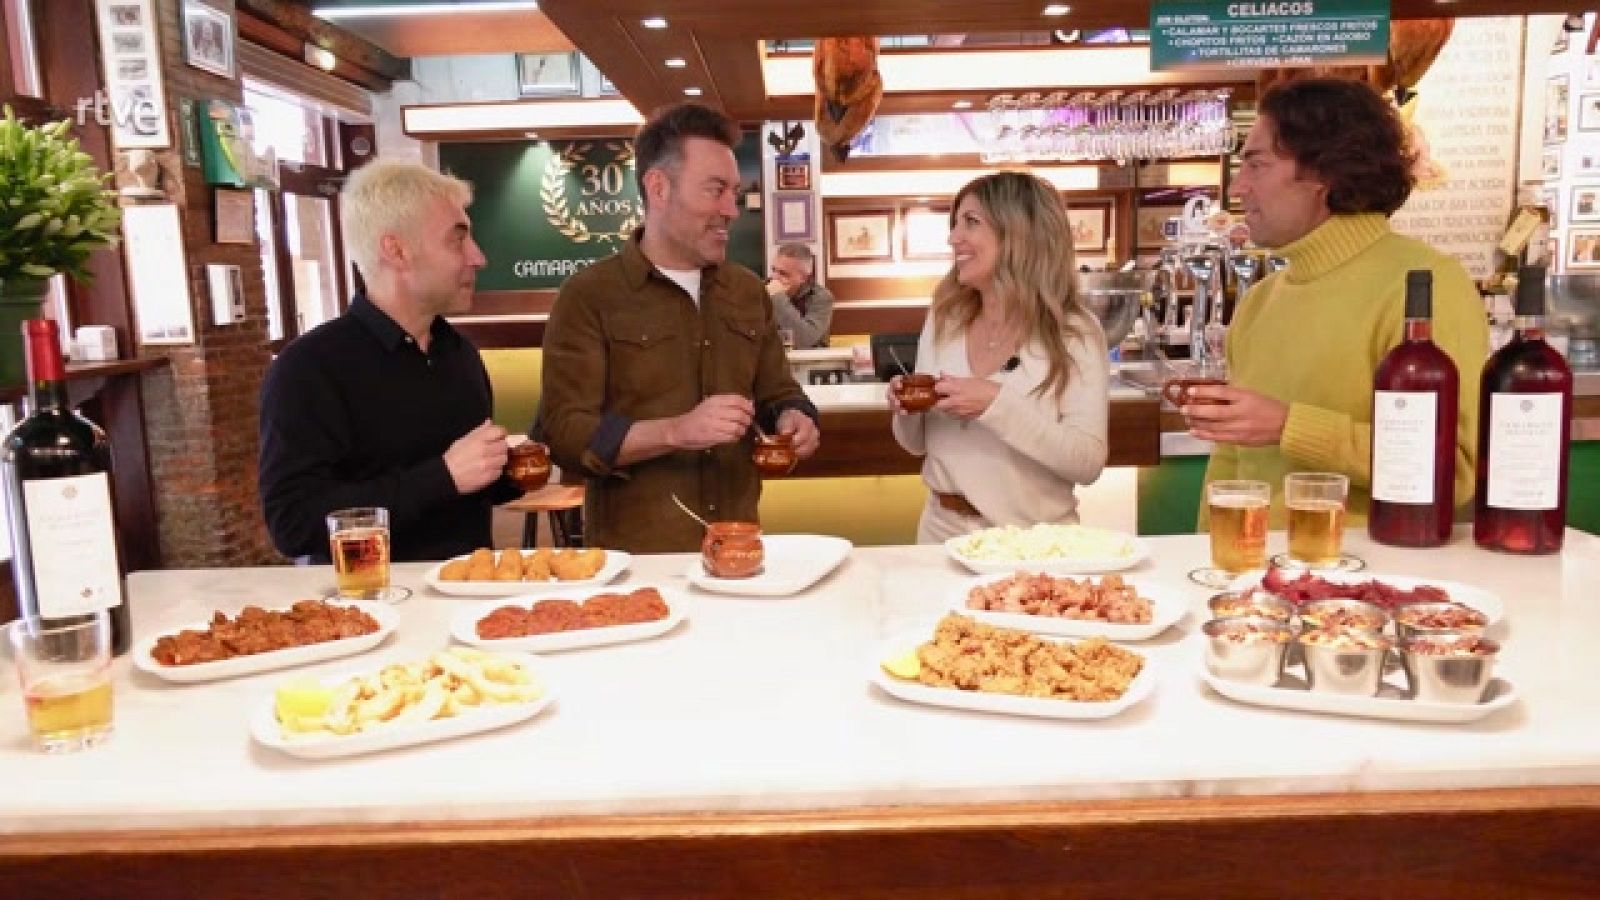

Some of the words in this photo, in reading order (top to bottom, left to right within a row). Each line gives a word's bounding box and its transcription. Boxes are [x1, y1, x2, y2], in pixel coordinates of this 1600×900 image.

[1227, 2, 1313, 17] CELIACOS
[1170, 26, 1219, 36] CALAMAR
[1340, 20, 1378, 30] FRITOS
[1229, 35, 1266, 45] FRITOS
[1333, 31, 1371, 41] ADOBO
[1265, 46, 1279, 55] DE
[581, 163, 624, 196] 30
[575, 196, 632, 216] AÑOS
